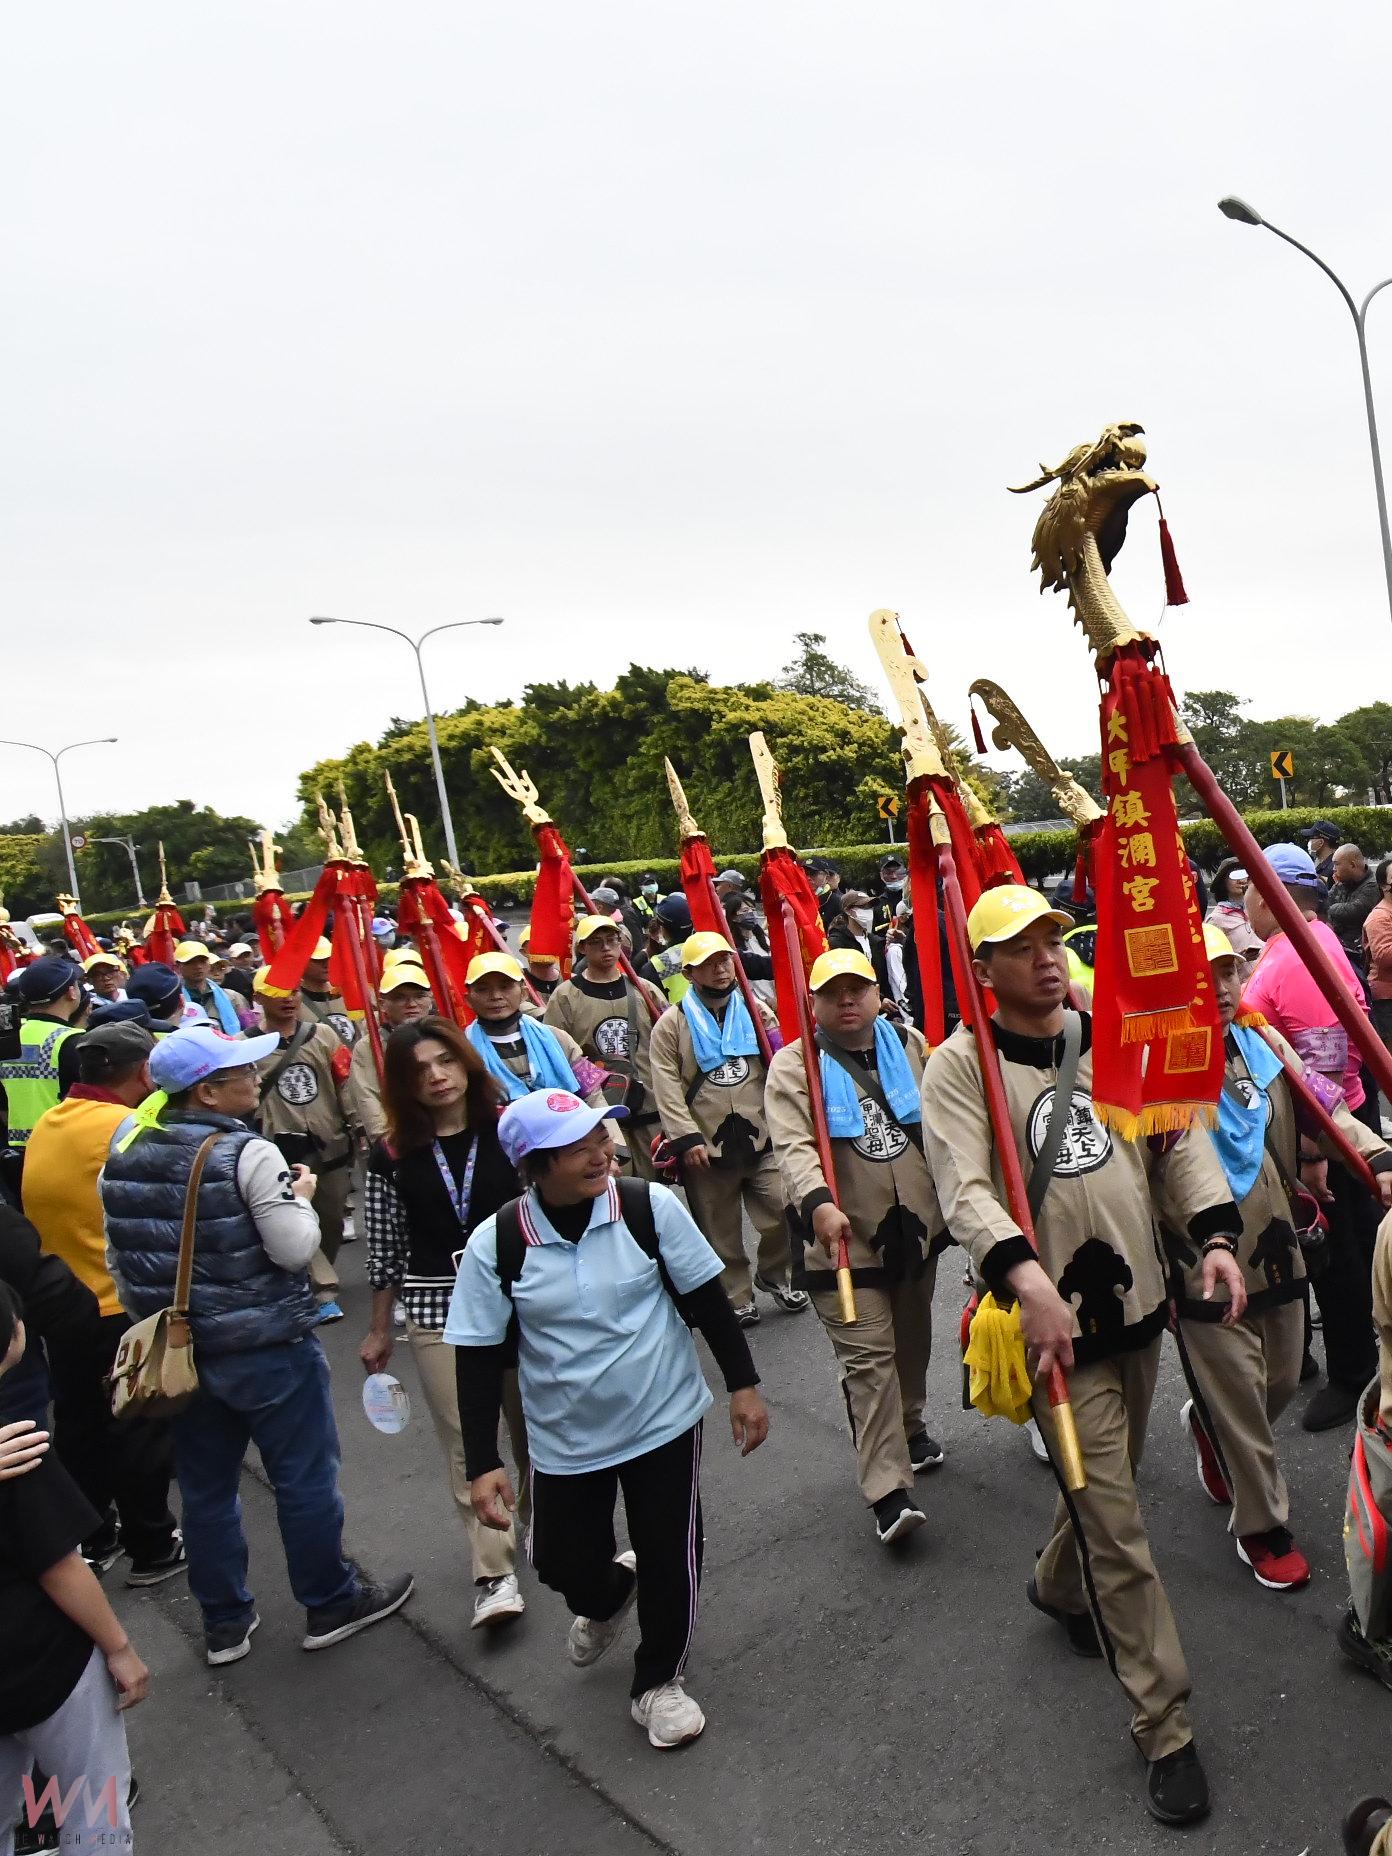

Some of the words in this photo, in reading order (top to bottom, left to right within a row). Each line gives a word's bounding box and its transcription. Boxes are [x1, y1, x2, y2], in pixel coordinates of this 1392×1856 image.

[1107, 708, 1160, 913] 大甲鎮瀾宮
